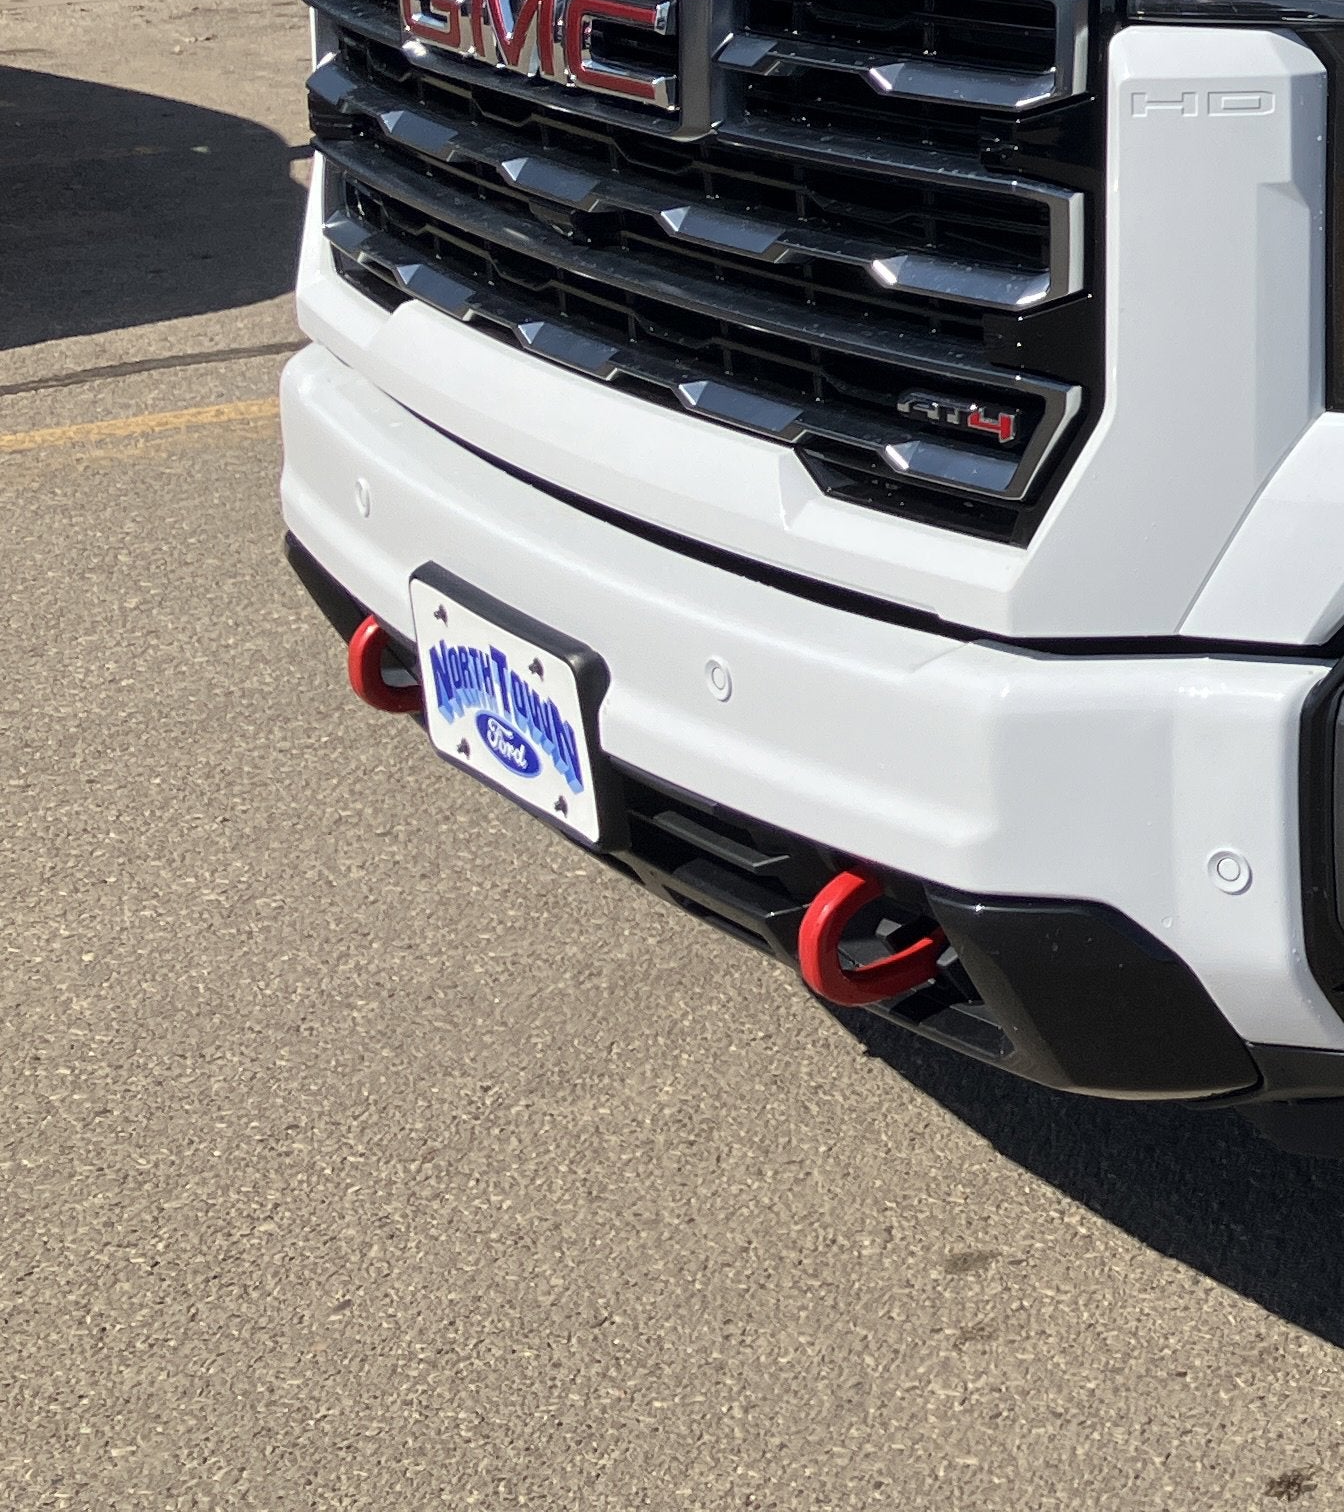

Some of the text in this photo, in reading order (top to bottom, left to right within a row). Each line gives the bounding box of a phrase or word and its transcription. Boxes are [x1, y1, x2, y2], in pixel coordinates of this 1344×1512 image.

[1131, 90, 1276, 117] HD
[896, 391, 1018, 442] AT4
[486, 719, 529, 770] Ford
